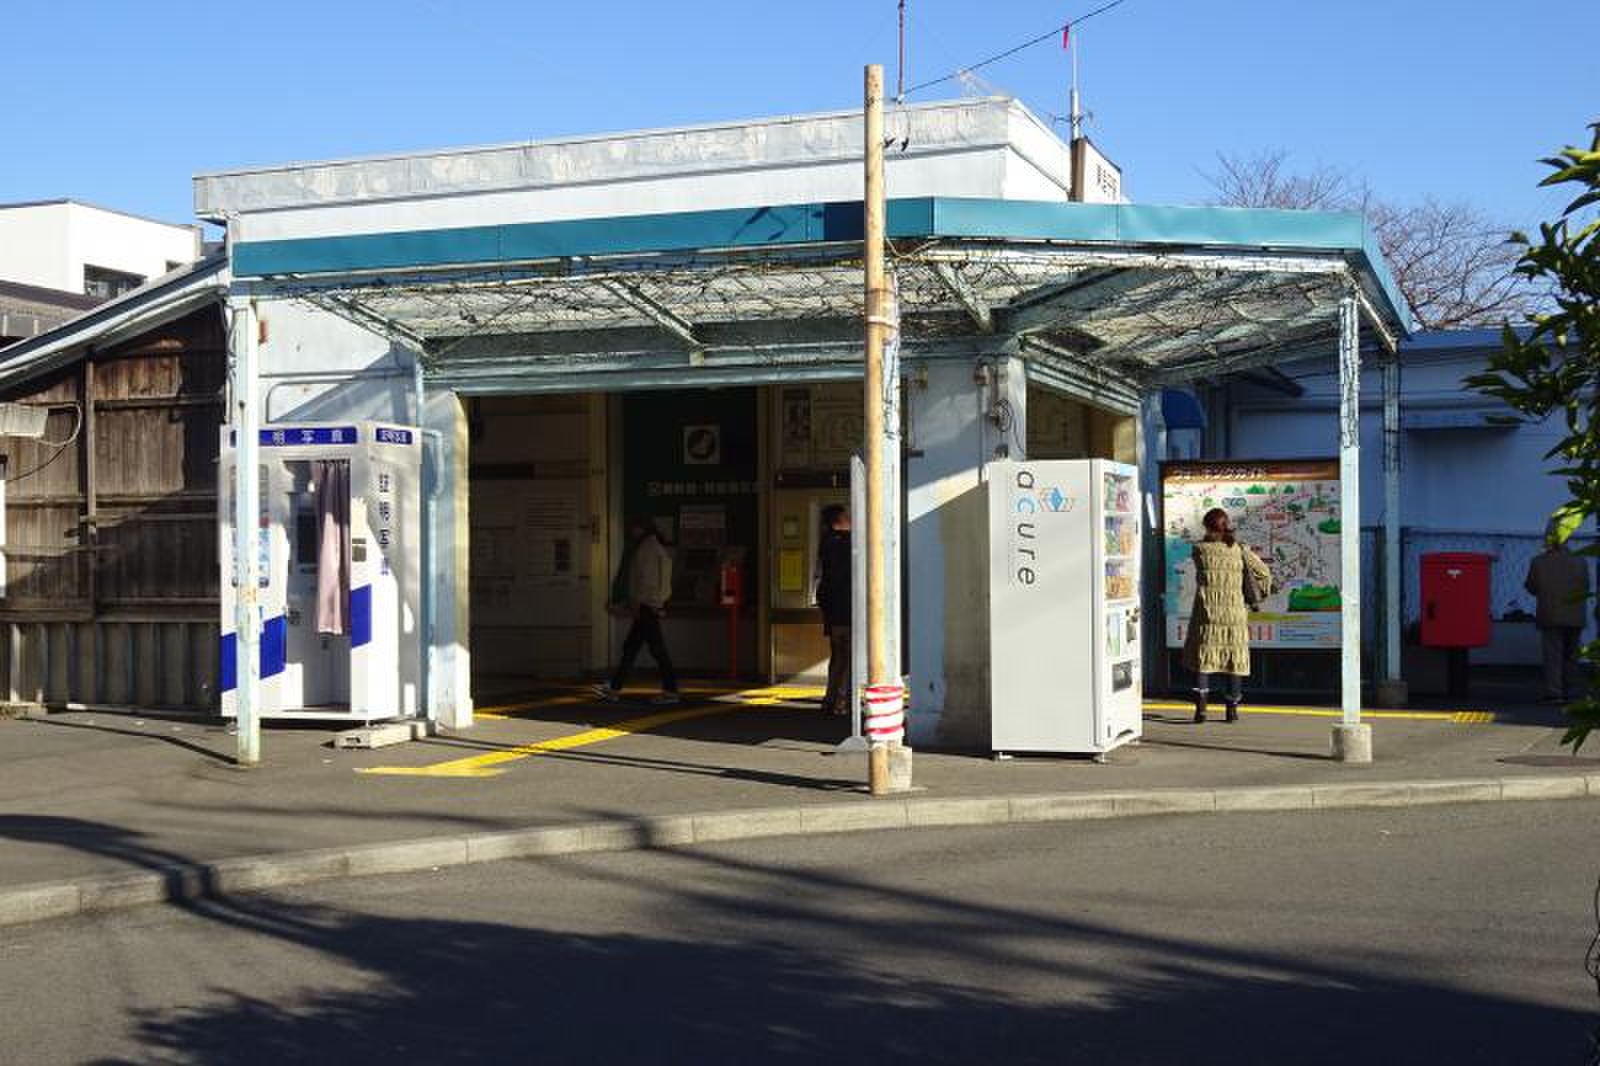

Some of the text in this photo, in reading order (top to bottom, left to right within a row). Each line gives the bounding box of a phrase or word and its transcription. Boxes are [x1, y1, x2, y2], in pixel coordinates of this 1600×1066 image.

[271, 429, 344, 446] 明写真
[1016, 471, 1036, 585] acure
